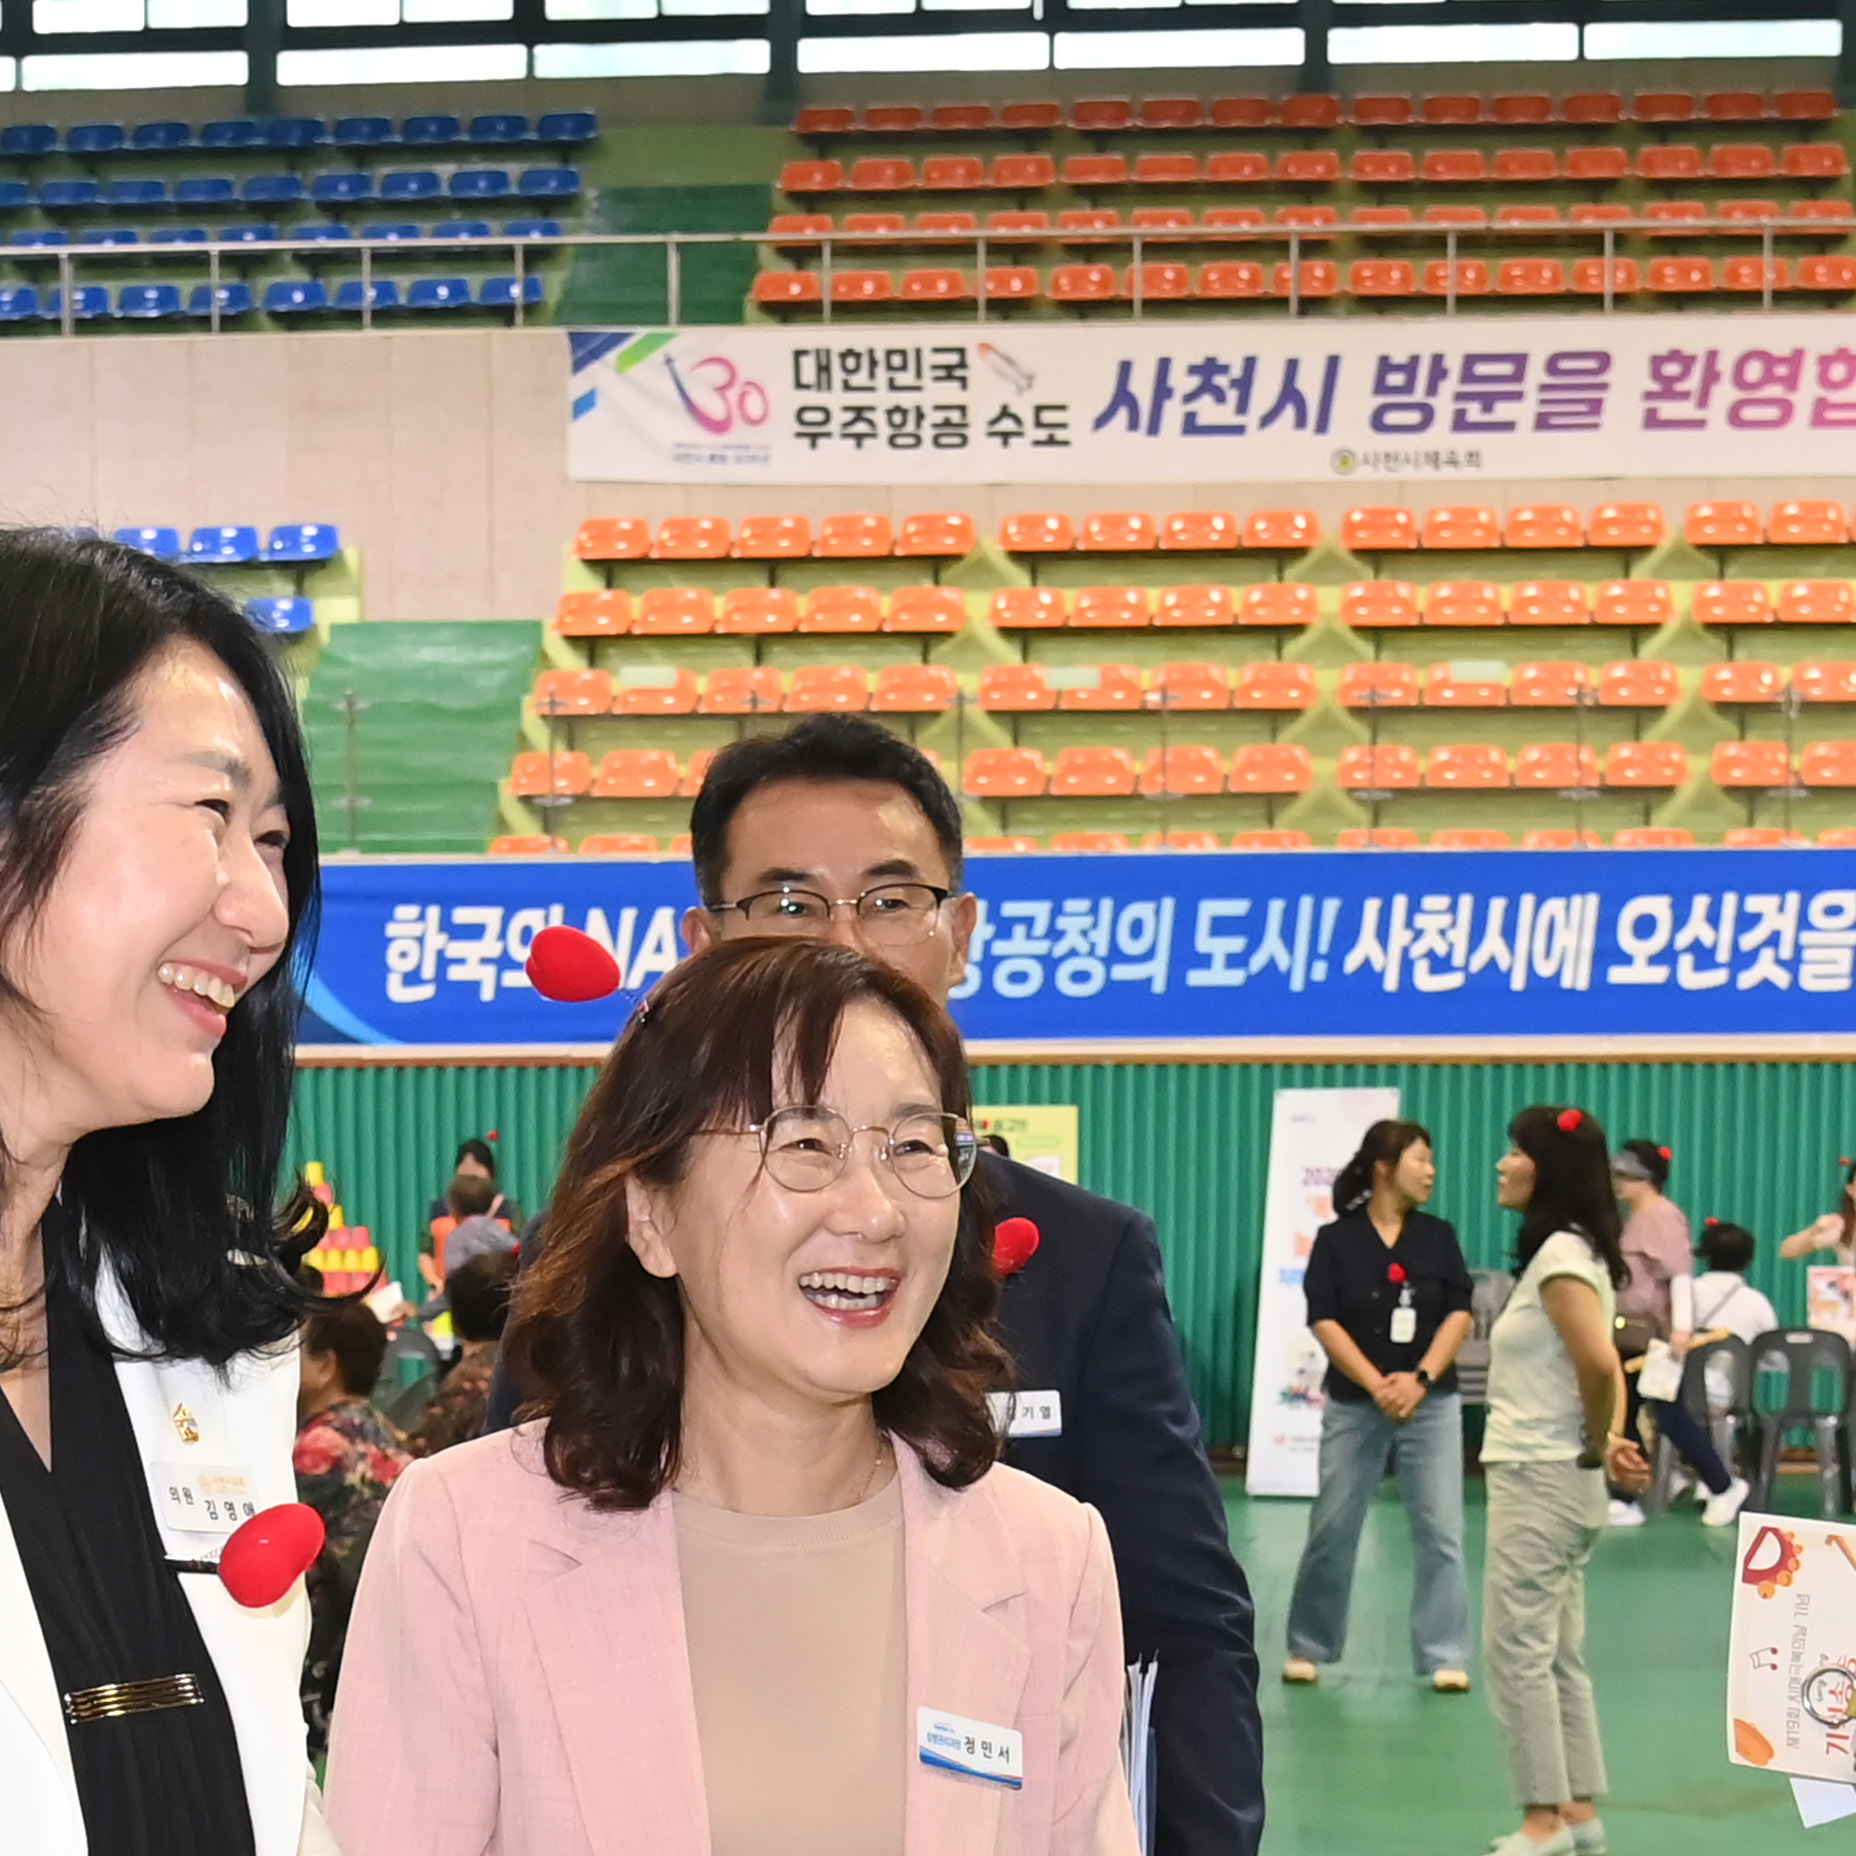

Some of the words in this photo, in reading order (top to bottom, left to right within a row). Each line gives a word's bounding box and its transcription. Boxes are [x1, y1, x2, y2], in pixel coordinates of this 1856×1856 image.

[791, 345, 971, 395] 대한민국
[1093, 352, 1343, 438] 사천시
[1369, 349, 1614, 437] 방문을
[793, 403, 971, 451] 우주항공
[984, 403, 1073, 449] 수도
[1184, 893, 1343, 993] 도시!
[1343, 892, 1601, 994] 사천시에
[168, 1485, 195, 1506] 의원
